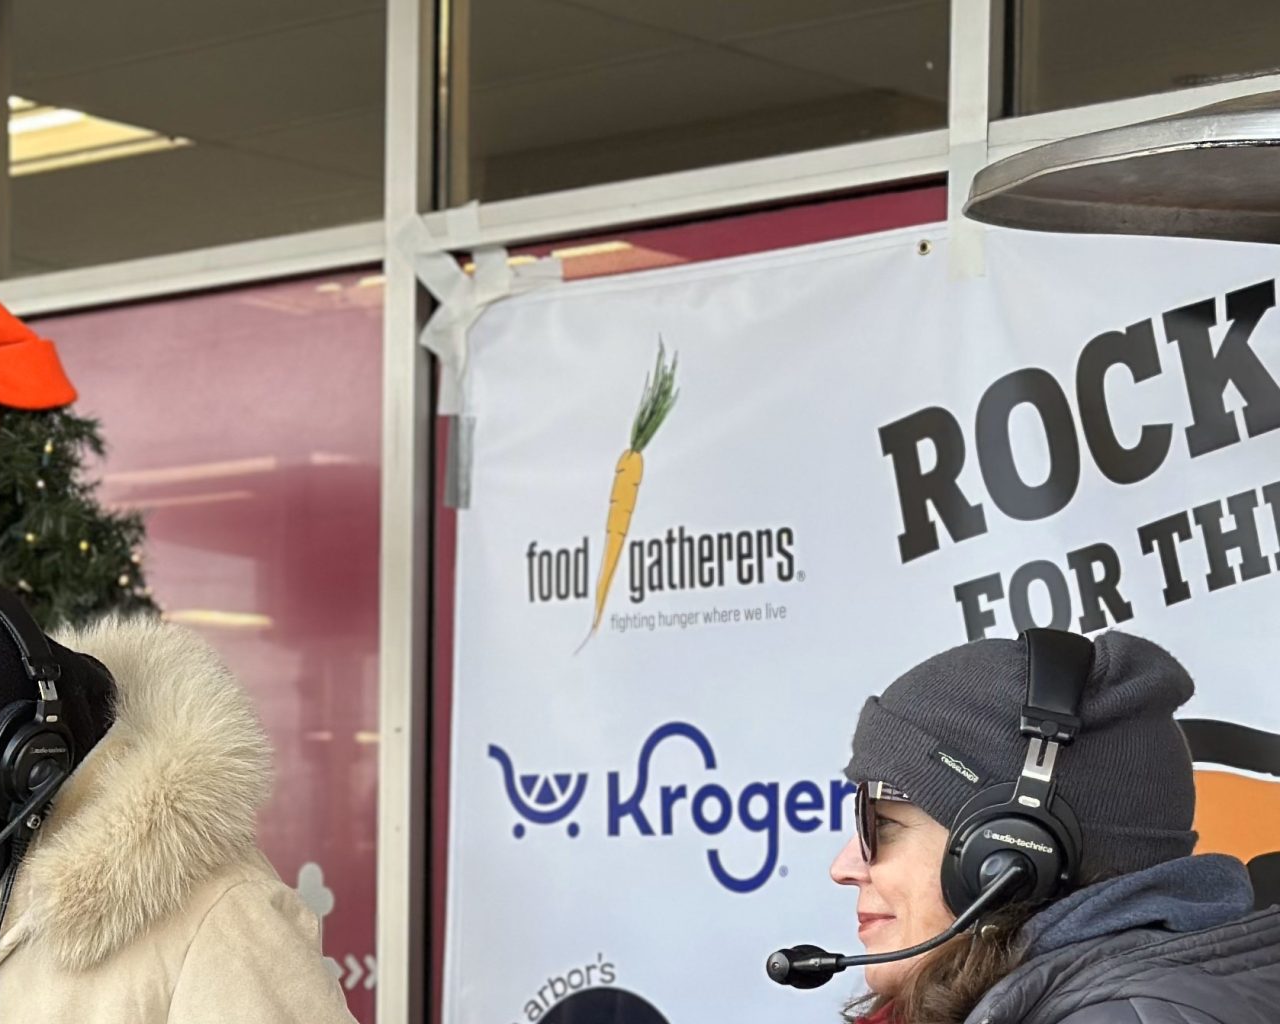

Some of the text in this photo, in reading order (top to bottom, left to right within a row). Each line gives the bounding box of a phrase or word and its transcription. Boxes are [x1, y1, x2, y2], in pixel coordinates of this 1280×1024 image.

[878, 278, 1280, 564] ROCK
[526, 525, 795, 603] food gatherers
[953, 480, 1280, 642] FOR TH
[610, 602, 787, 633] fighting hunger where we live
[991, 832, 1054, 854] audio-technica
[523, 952, 616, 1023] arbor's
